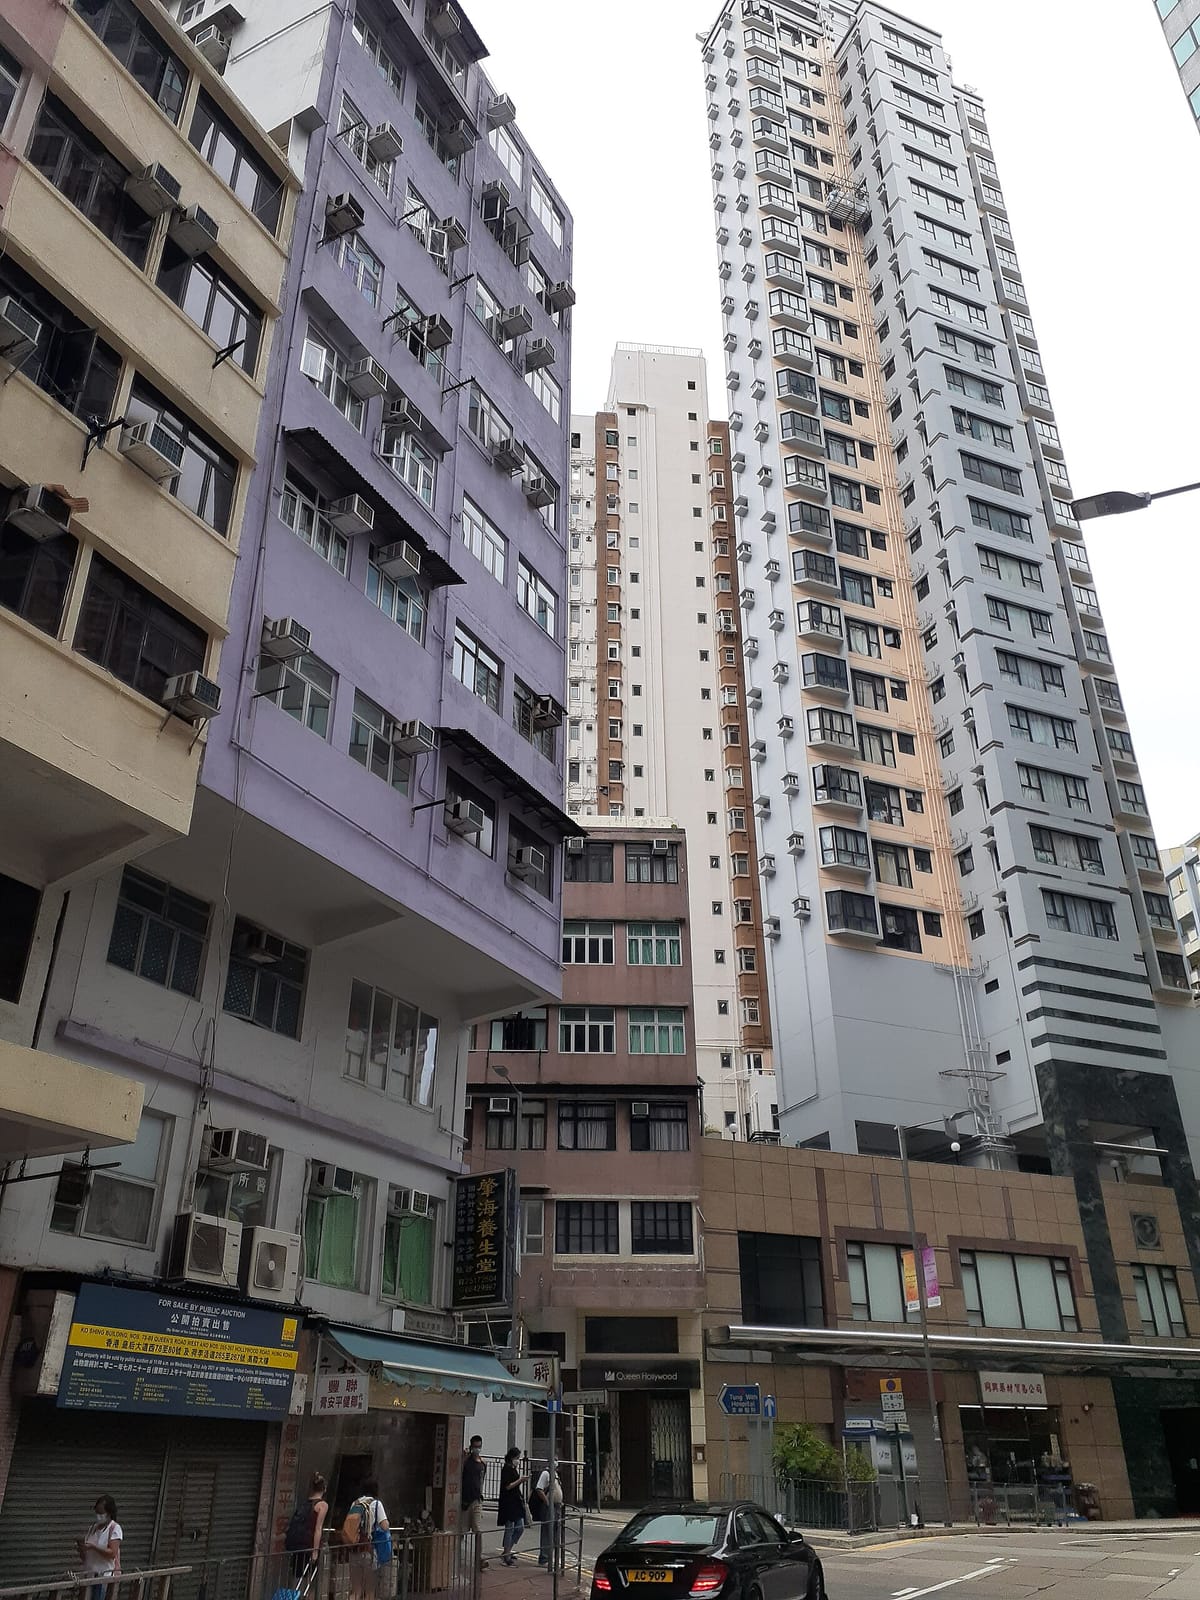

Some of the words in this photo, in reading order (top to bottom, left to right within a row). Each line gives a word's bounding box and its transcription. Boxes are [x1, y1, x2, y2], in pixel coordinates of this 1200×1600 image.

[475, 1177, 499, 1274] 肇海養生堂
[158, 1298, 171, 1307] FOR
[172, 1301, 189, 1310] SALE
[189, 1303, 198, 1311] BY
[198, 1305, 221, 1315] PUBLIC
[220, 1308, 246, 1319] AUCTION
[170, 1313, 231, 1331] 公開拍賣出售
[106, 1338, 120, 1348] 香港
[84, 1352, 99, 1360] property
[616, 1371, 641, 1381] Queen
[730, 1394, 743, 1402] Tung
[649, 1570, 666, 1580] 909
